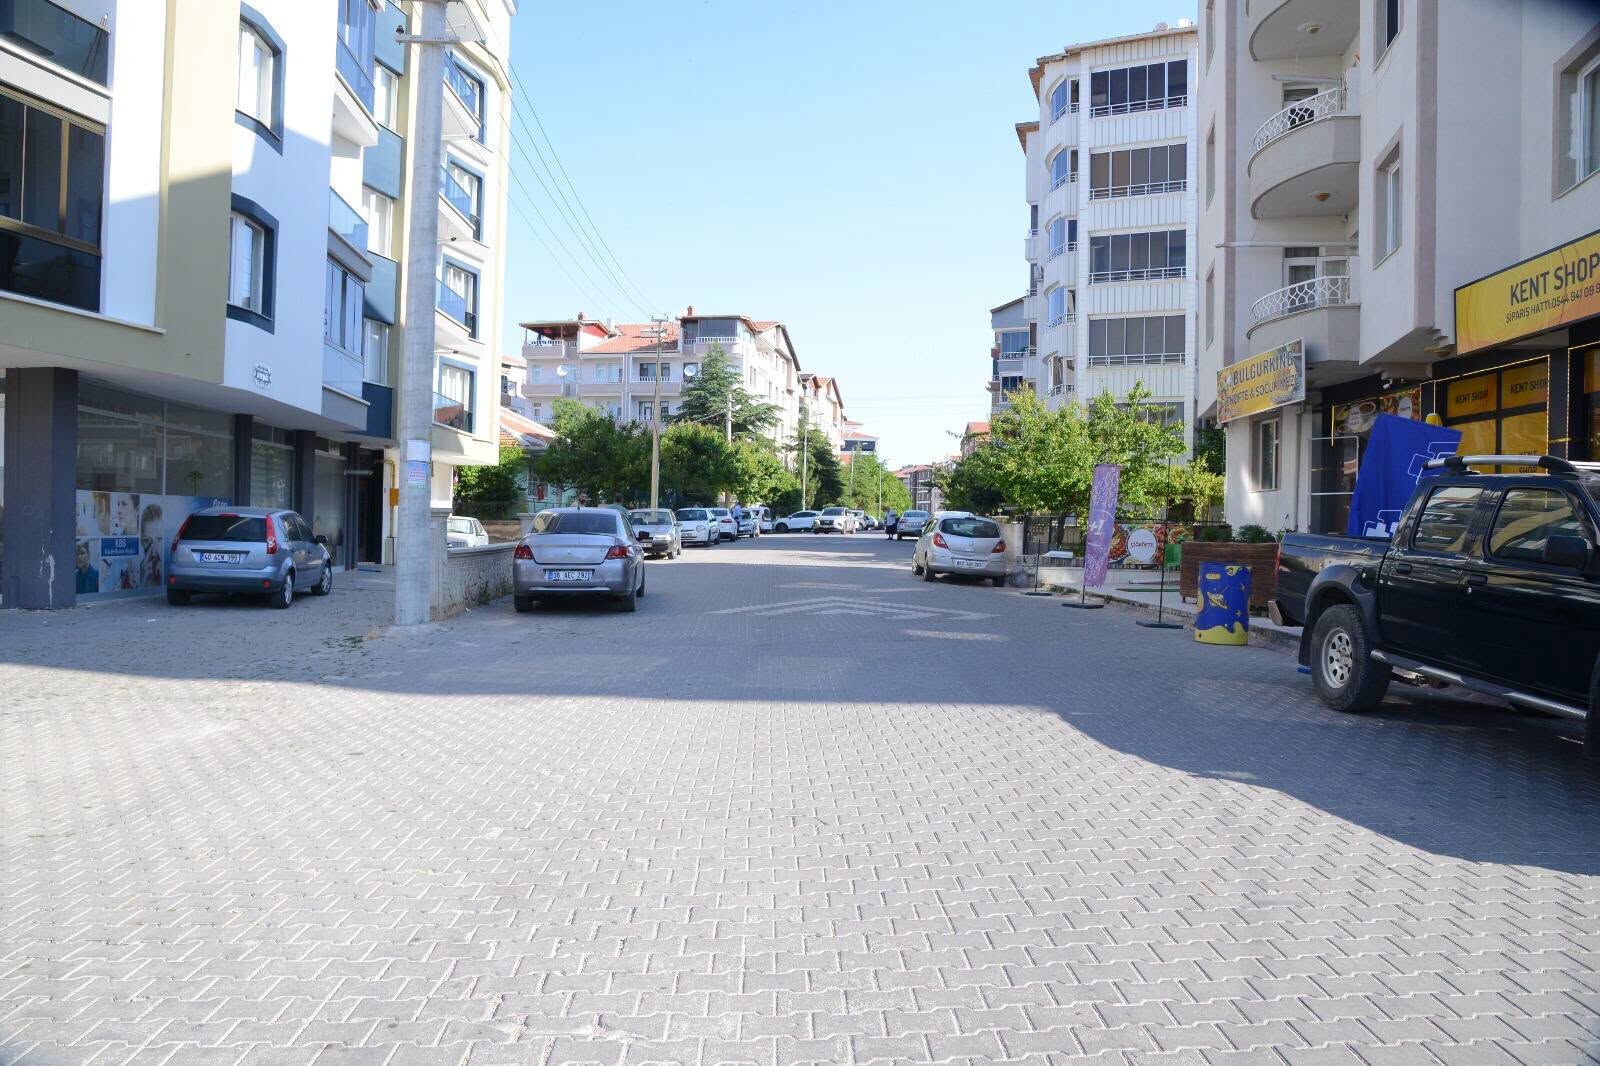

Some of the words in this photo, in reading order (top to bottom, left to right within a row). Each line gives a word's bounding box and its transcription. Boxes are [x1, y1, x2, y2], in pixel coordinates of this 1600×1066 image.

[1510, 270, 1550, 306] KENT
[1553, 252, 1600, 291] SHOP
[1510, 381, 1529, 394] KENT
[1455, 393, 1470, 404] KENT
[1471, 389, 1489, 401] SHOP
